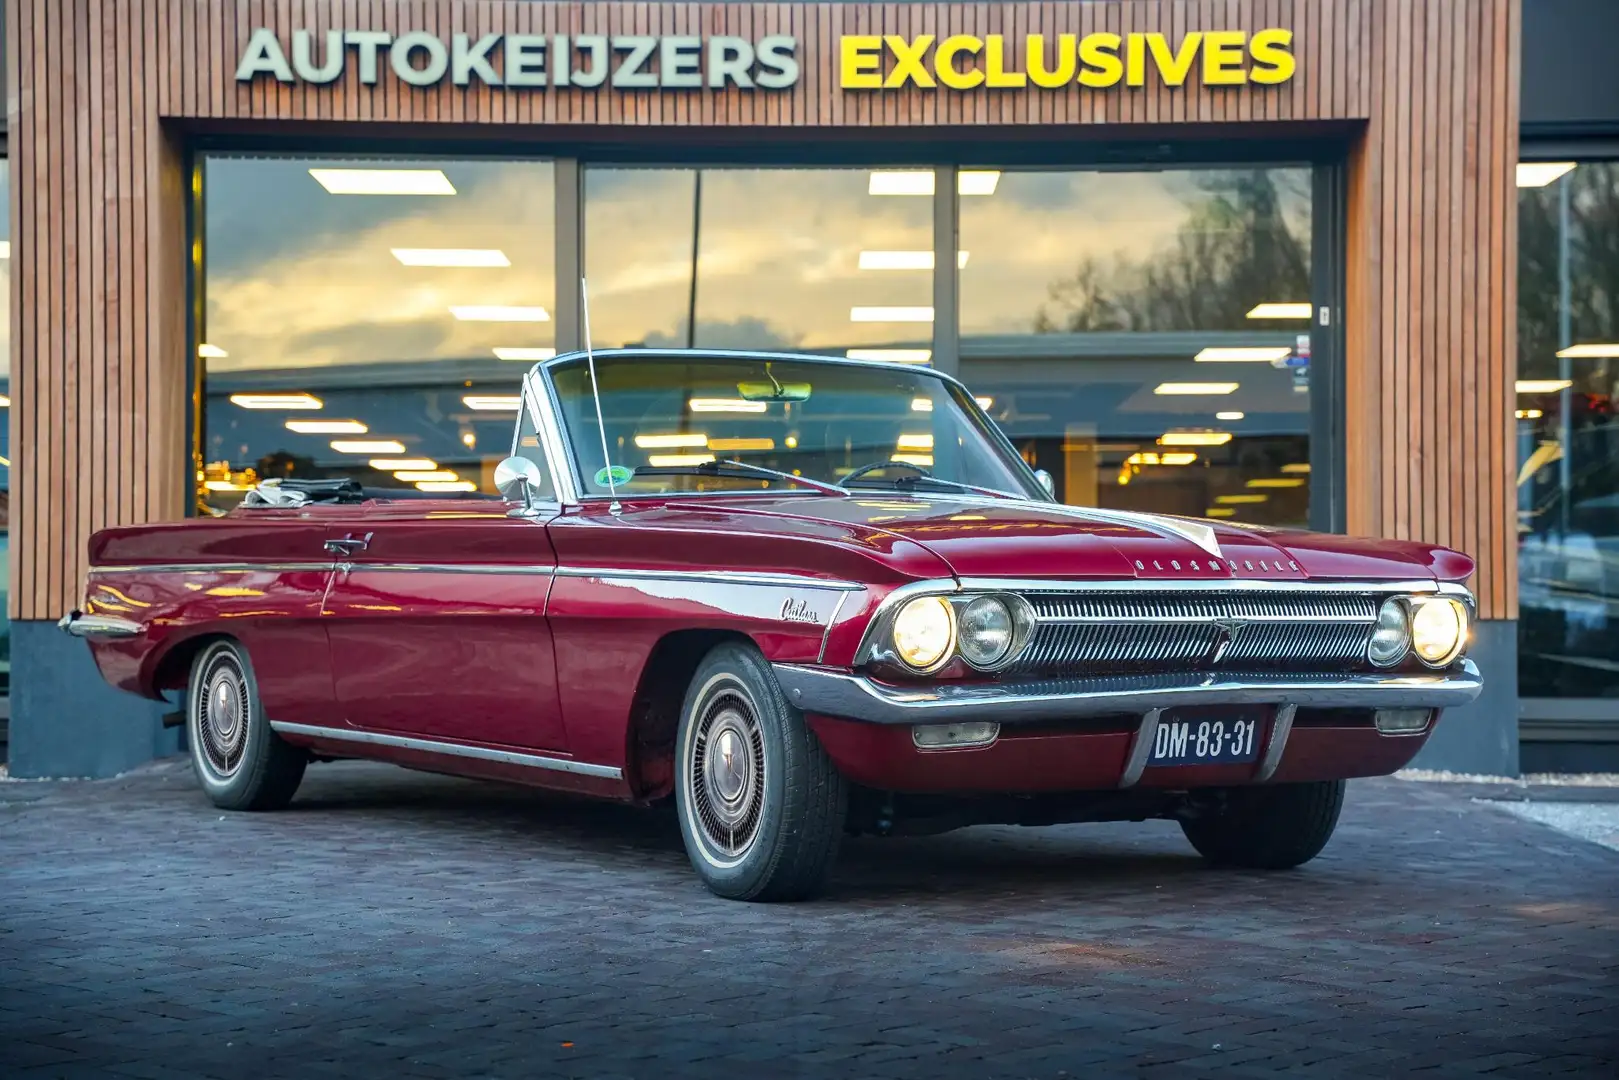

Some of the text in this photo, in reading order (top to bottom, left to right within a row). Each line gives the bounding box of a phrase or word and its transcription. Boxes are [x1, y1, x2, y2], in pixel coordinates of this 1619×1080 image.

[234, 28, 1296, 89] AUTOKEIJZERS EXCLUSIVES
[1135, 559, 1299, 572] OLDSMOBILE
[1154, 720, 1255, 759] DM-83-31
